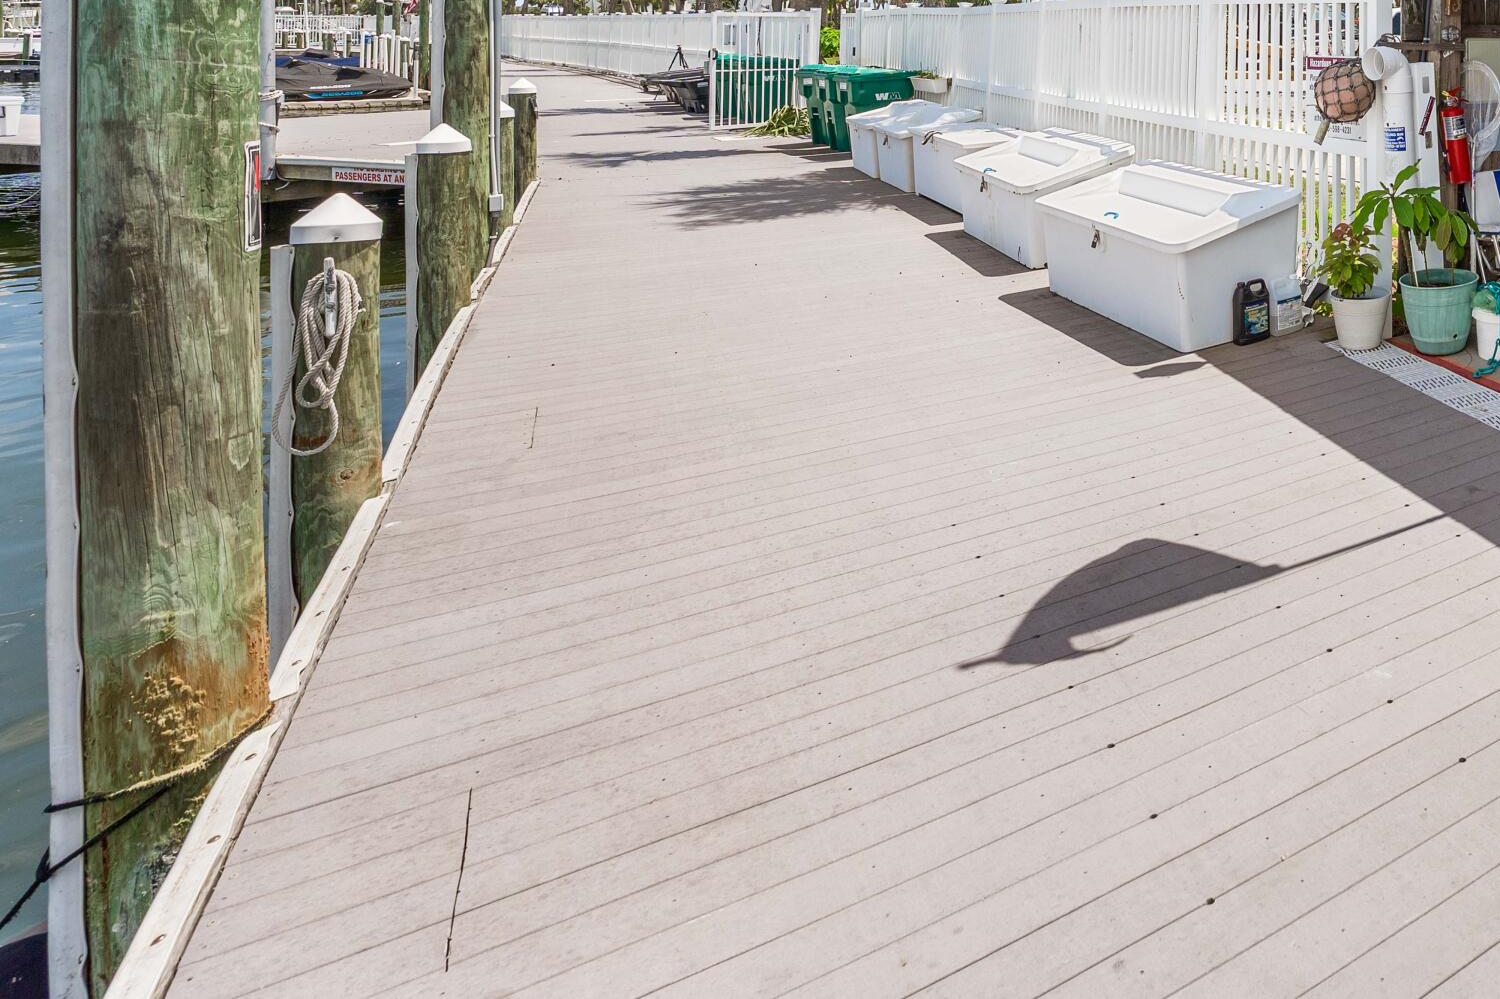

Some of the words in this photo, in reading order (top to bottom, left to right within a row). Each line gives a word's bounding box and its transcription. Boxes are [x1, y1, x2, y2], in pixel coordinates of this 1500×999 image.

[875, 92, 901, 100] WM
[335, 172, 381, 182] PASSENGERS
[383, 175, 392, 183] AT
[394, 175, 405, 183] AN
